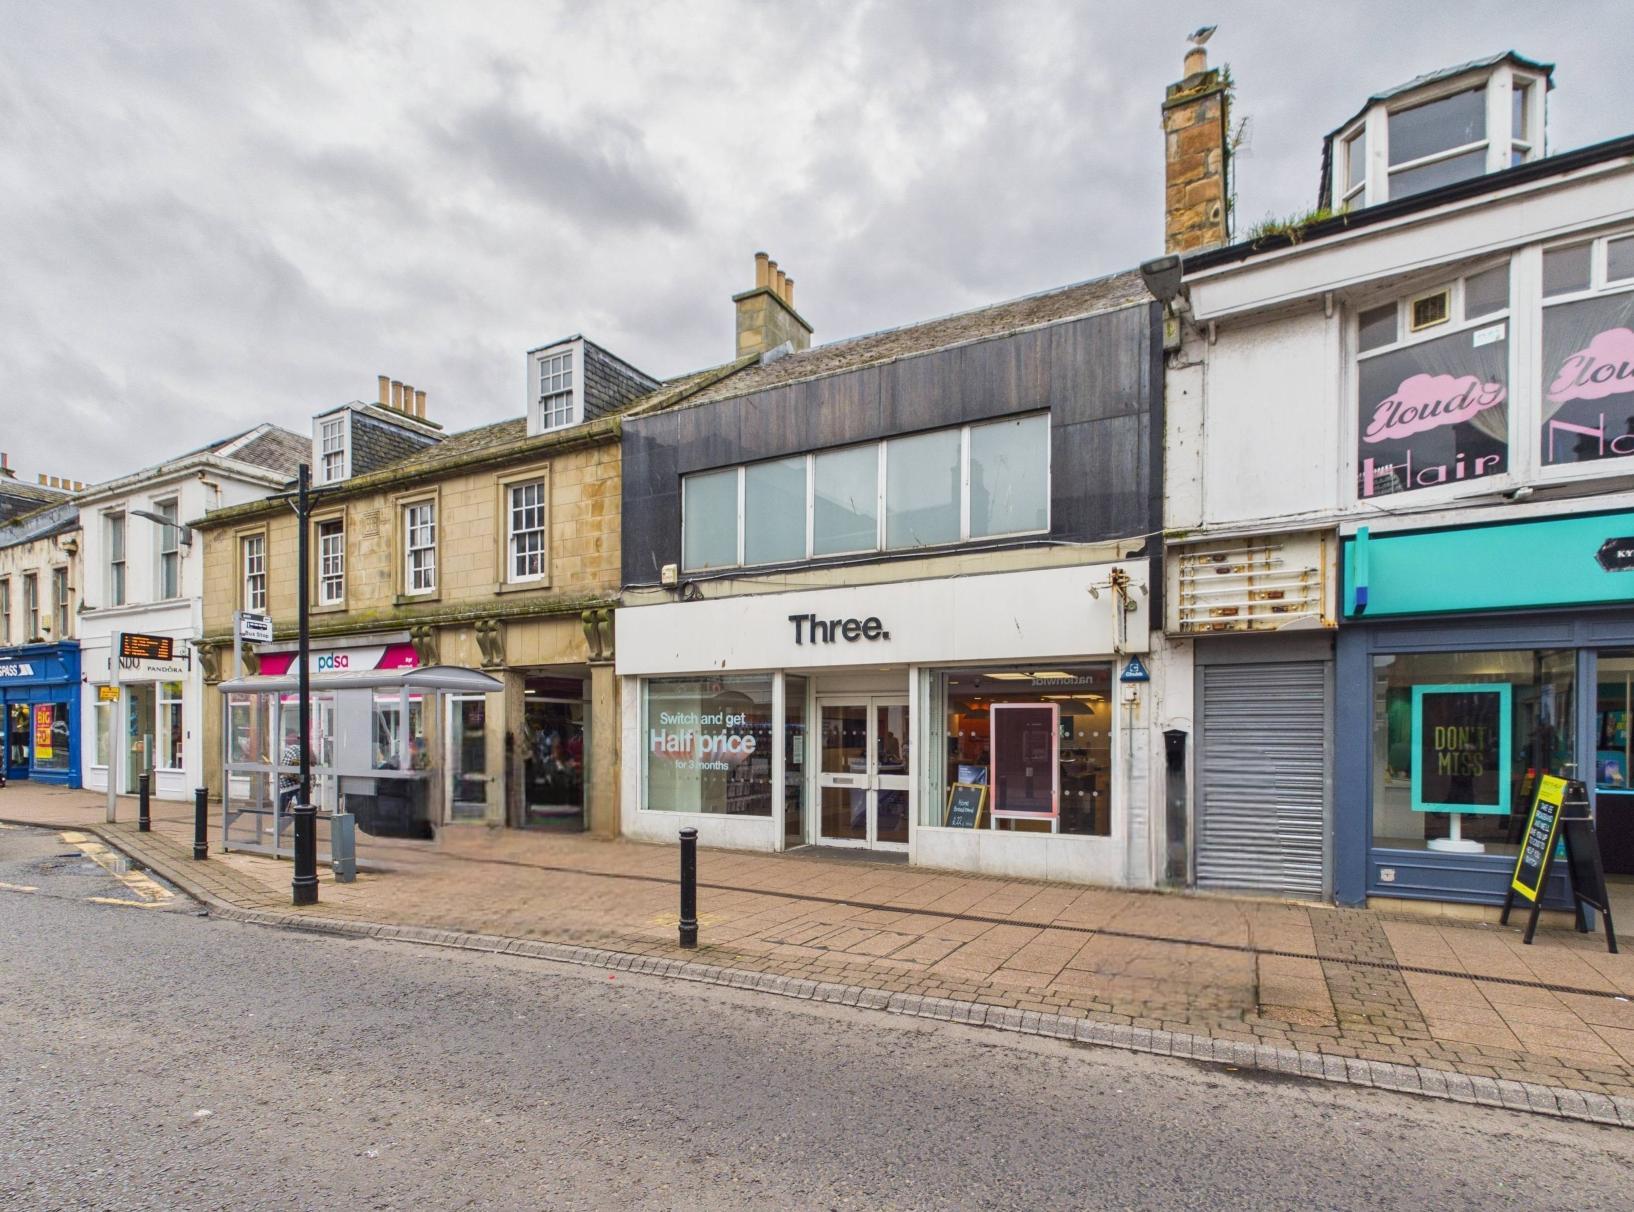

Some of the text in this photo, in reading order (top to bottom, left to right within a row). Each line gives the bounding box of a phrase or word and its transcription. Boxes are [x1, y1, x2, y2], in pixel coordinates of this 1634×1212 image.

[1363, 449, 1499, 497] Hair
[788, 613, 891, 645] Three.
[318, 651, 349, 672] pdsa
[660, 712, 746, 728] Switch and get
[651, 728, 757, 759] Half price
[675, 759, 687, 769] for
[696, 761, 729, 771] months
[1438, 751, 1484, 777] MISS
